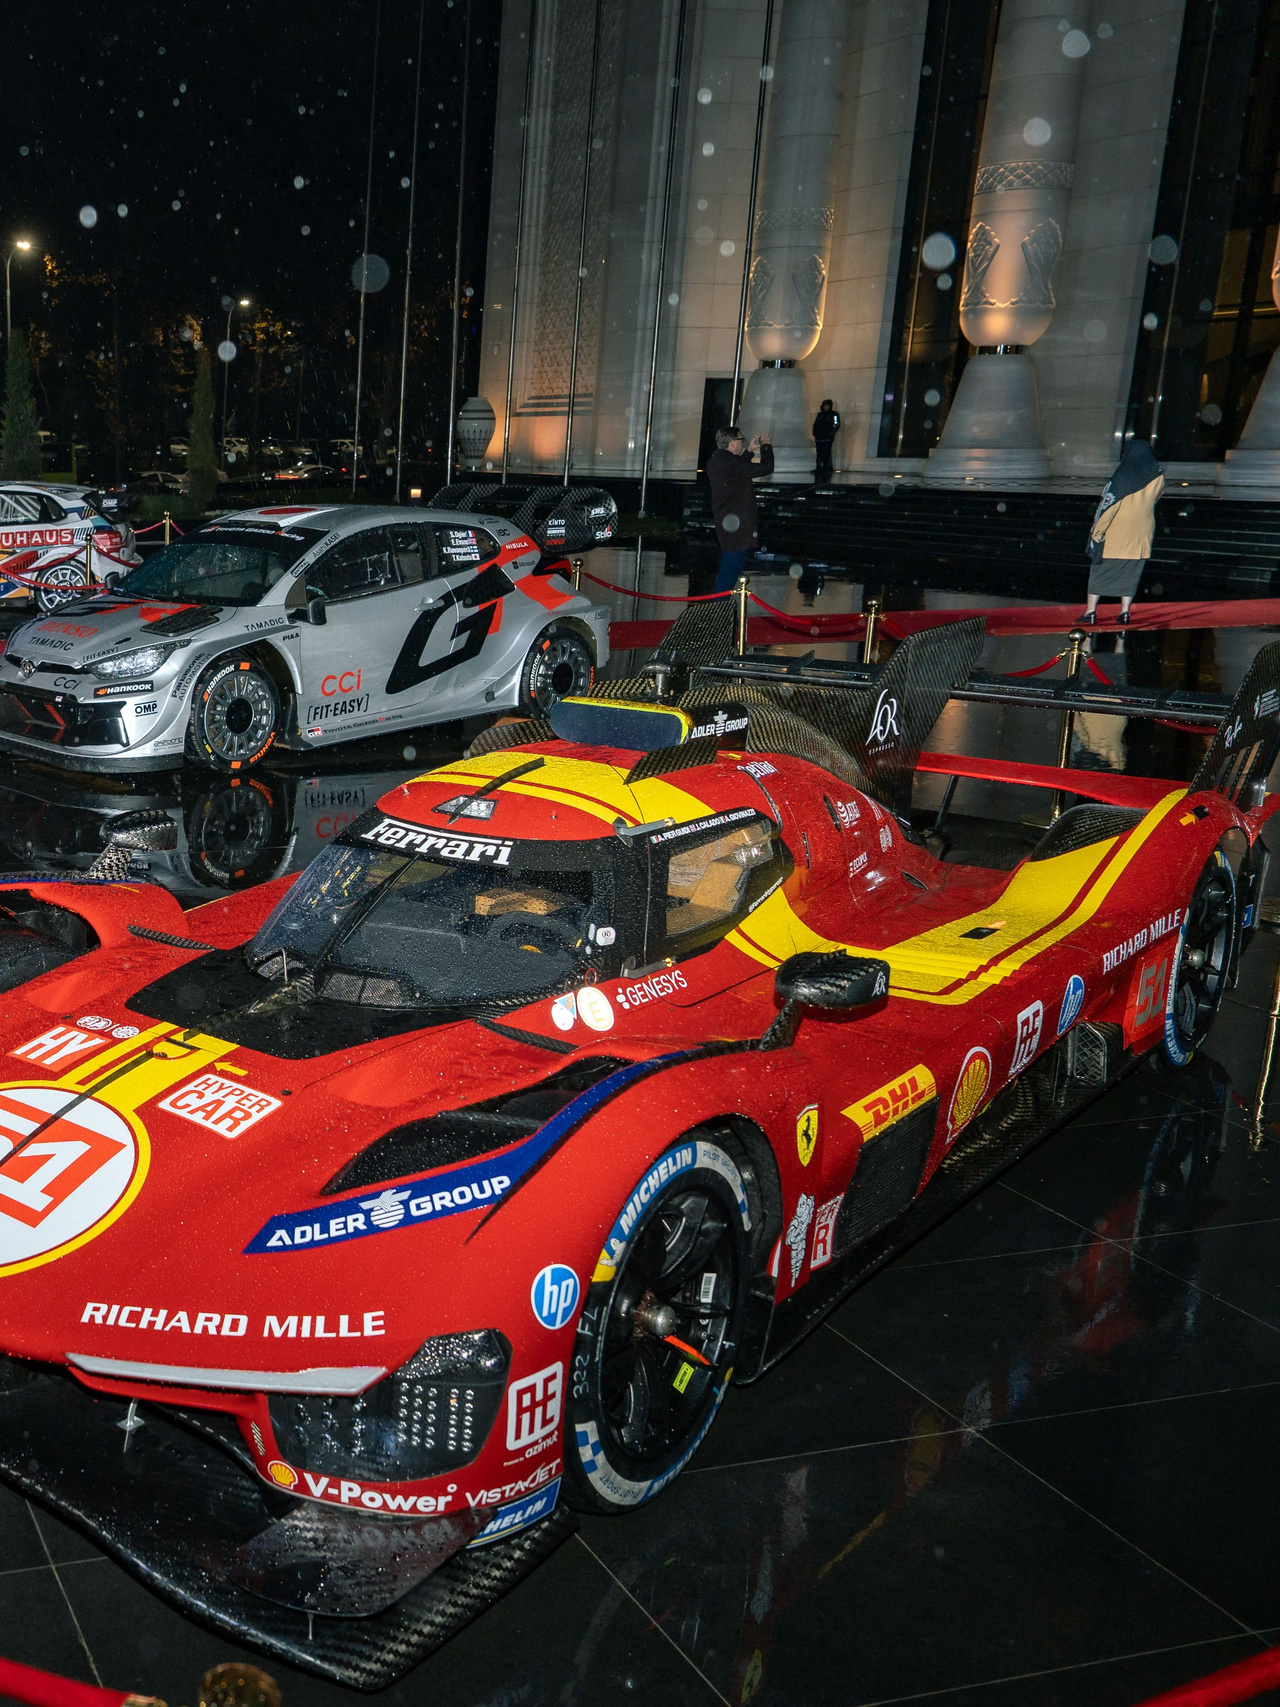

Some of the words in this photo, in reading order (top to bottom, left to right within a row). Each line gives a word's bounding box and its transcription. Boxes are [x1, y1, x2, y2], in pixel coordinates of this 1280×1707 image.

[324, 532, 341, 548] KASEI
[28, 636, 74, 651] TAMADIC
[38, 621, 99, 638] DENSO
[244, 617, 284, 632] TAMADIC
[282, 632, 300, 642] PIAA
[171, 652, 206, 698] Panasonic
[178, 653, 212, 702] AUTOMOTIVE
[134, 702, 158, 715] OMP
[690, 724, 715, 739] ADLER
[725, 718, 748, 732] GROUP
[868, 742, 895, 755] ESPRESSO
[360, 818, 514, 866] Ferrari
[1102, 932, 1148, 975] RICHARD
[1150, 908, 1182, 938] MILLE
[626, 970, 688, 1006] GENESYS
[1135, 957, 1168, 1028] 51
[13, 1026, 106, 1065] HY
[170, 1089, 256, 1134] CAR
[193, 1077, 272, 1114] HYPER
[862, 1075, 927, 1129] DHL
[703, 1150, 720, 1160] PILOT
[266, 1213, 368, 1247] ADLER
[409, 1175, 511, 1218] GROUP
[619, 1147, 693, 1237] MICHELIN
[541, 1269, 572, 1325] hp
[80, 1302, 249, 1338] RICHARD
[263, 1310, 386, 1338] MILLE
[573, 1354, 590, 1399] 322
[524, 1430, 559, 1459] azimut
[465, 1458, 561, 1507] VISTAJET
[480, 1496, 548, 1536] HELIN
